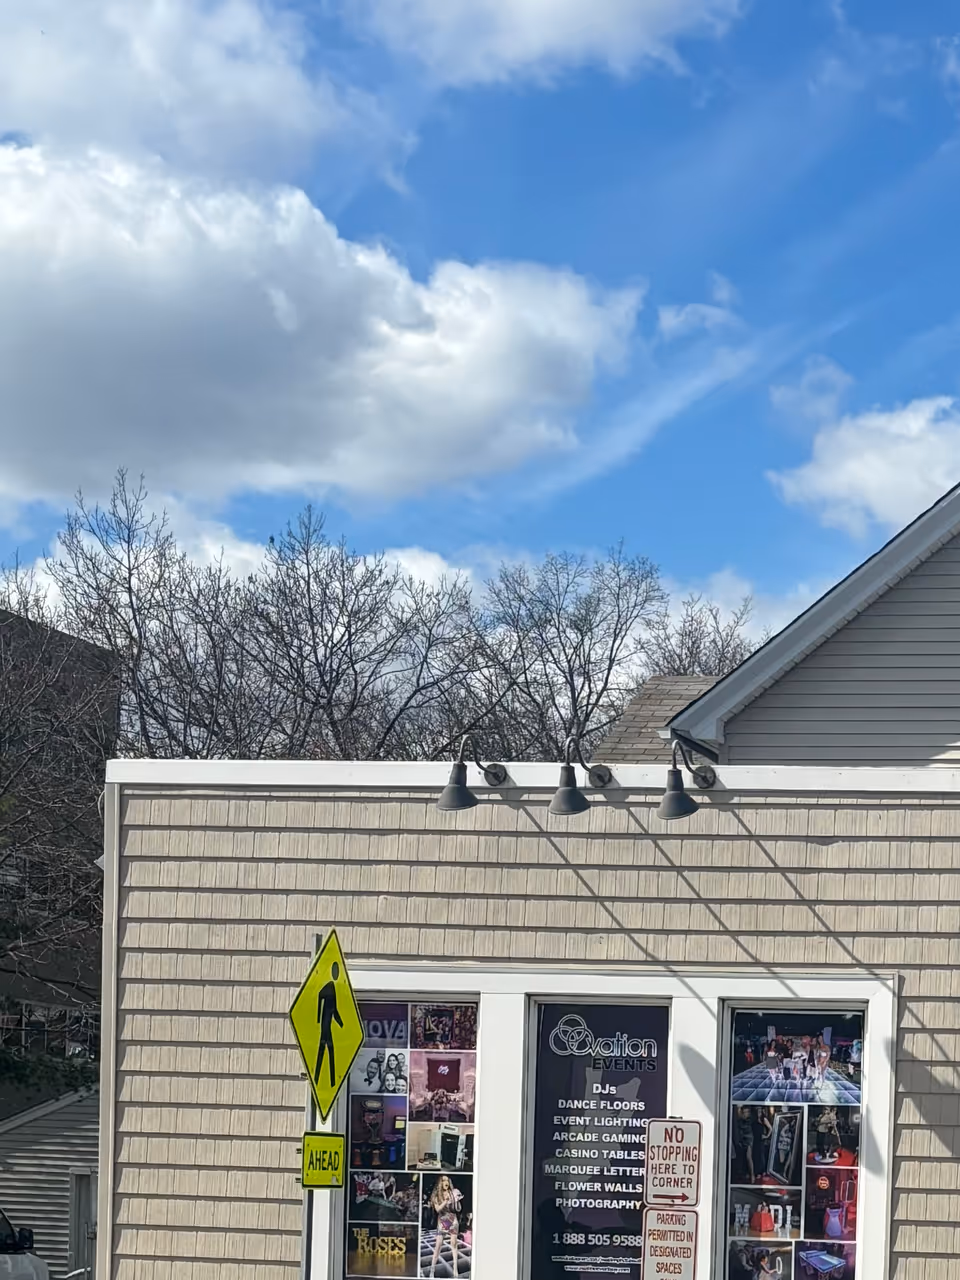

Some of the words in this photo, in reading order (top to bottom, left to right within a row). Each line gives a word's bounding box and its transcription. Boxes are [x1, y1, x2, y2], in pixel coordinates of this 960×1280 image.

[364, 1019, 408, 1039] OVA
[592, 1058, 657, 1072] EVENTS
[592, 1083, 617, 1094] DJs
[558, 1099, 597, 1109] DANCE
[600, 1101, 645, 1111] FLOORS
[553, 1116, 591, 1125] EVENT
[594, 1117, 648, 1127] LIGHTING
[553, 1132, 598, 1142] ARCADE
[602, 1134, 646, 1143] GAMING
[664, 1127, 684, 1143] NO
[555, 1149, 599, 1158] CASINO
[602, 1150, 645, 1160] TABLES
[650, 1145, 697, 1162] STOPPING
[308, 1150, 340, 1172] AHEAD
[544, 1165, 600, 1175] MARQUEE
[603, 1167, 645, 1176] LETTER
[651, 1164, 677, 1175] HERE
[683, 1164, 695, 1175] TO
[555, 1182, 601, 1192] FLOWER
[604, 1183, 643, 1193] WALLS
[652, 1177, 693, 1188] CORNER
[555, 1198, 642, 1210] PHOTOGRAPHY
[656, 1213, 686, 1226] PARKING
[352, 1228, 370, 1237] THE
[648, 1229, 685, 1242] PERMITTED
[687, 1231, 693, 1243] IN
[357, 1236, 406, 1255] ROSES
[552, 1233, 560, 1244] 1
[562, 1233, 586, 1245] 888
[587, 1234, 610, 1246] 505
[612, 1235, 643, 1247] 9588
[650, 1245, 692, 1259] DESIGNATED
[656, 1262, 682, 1274] SPACES
